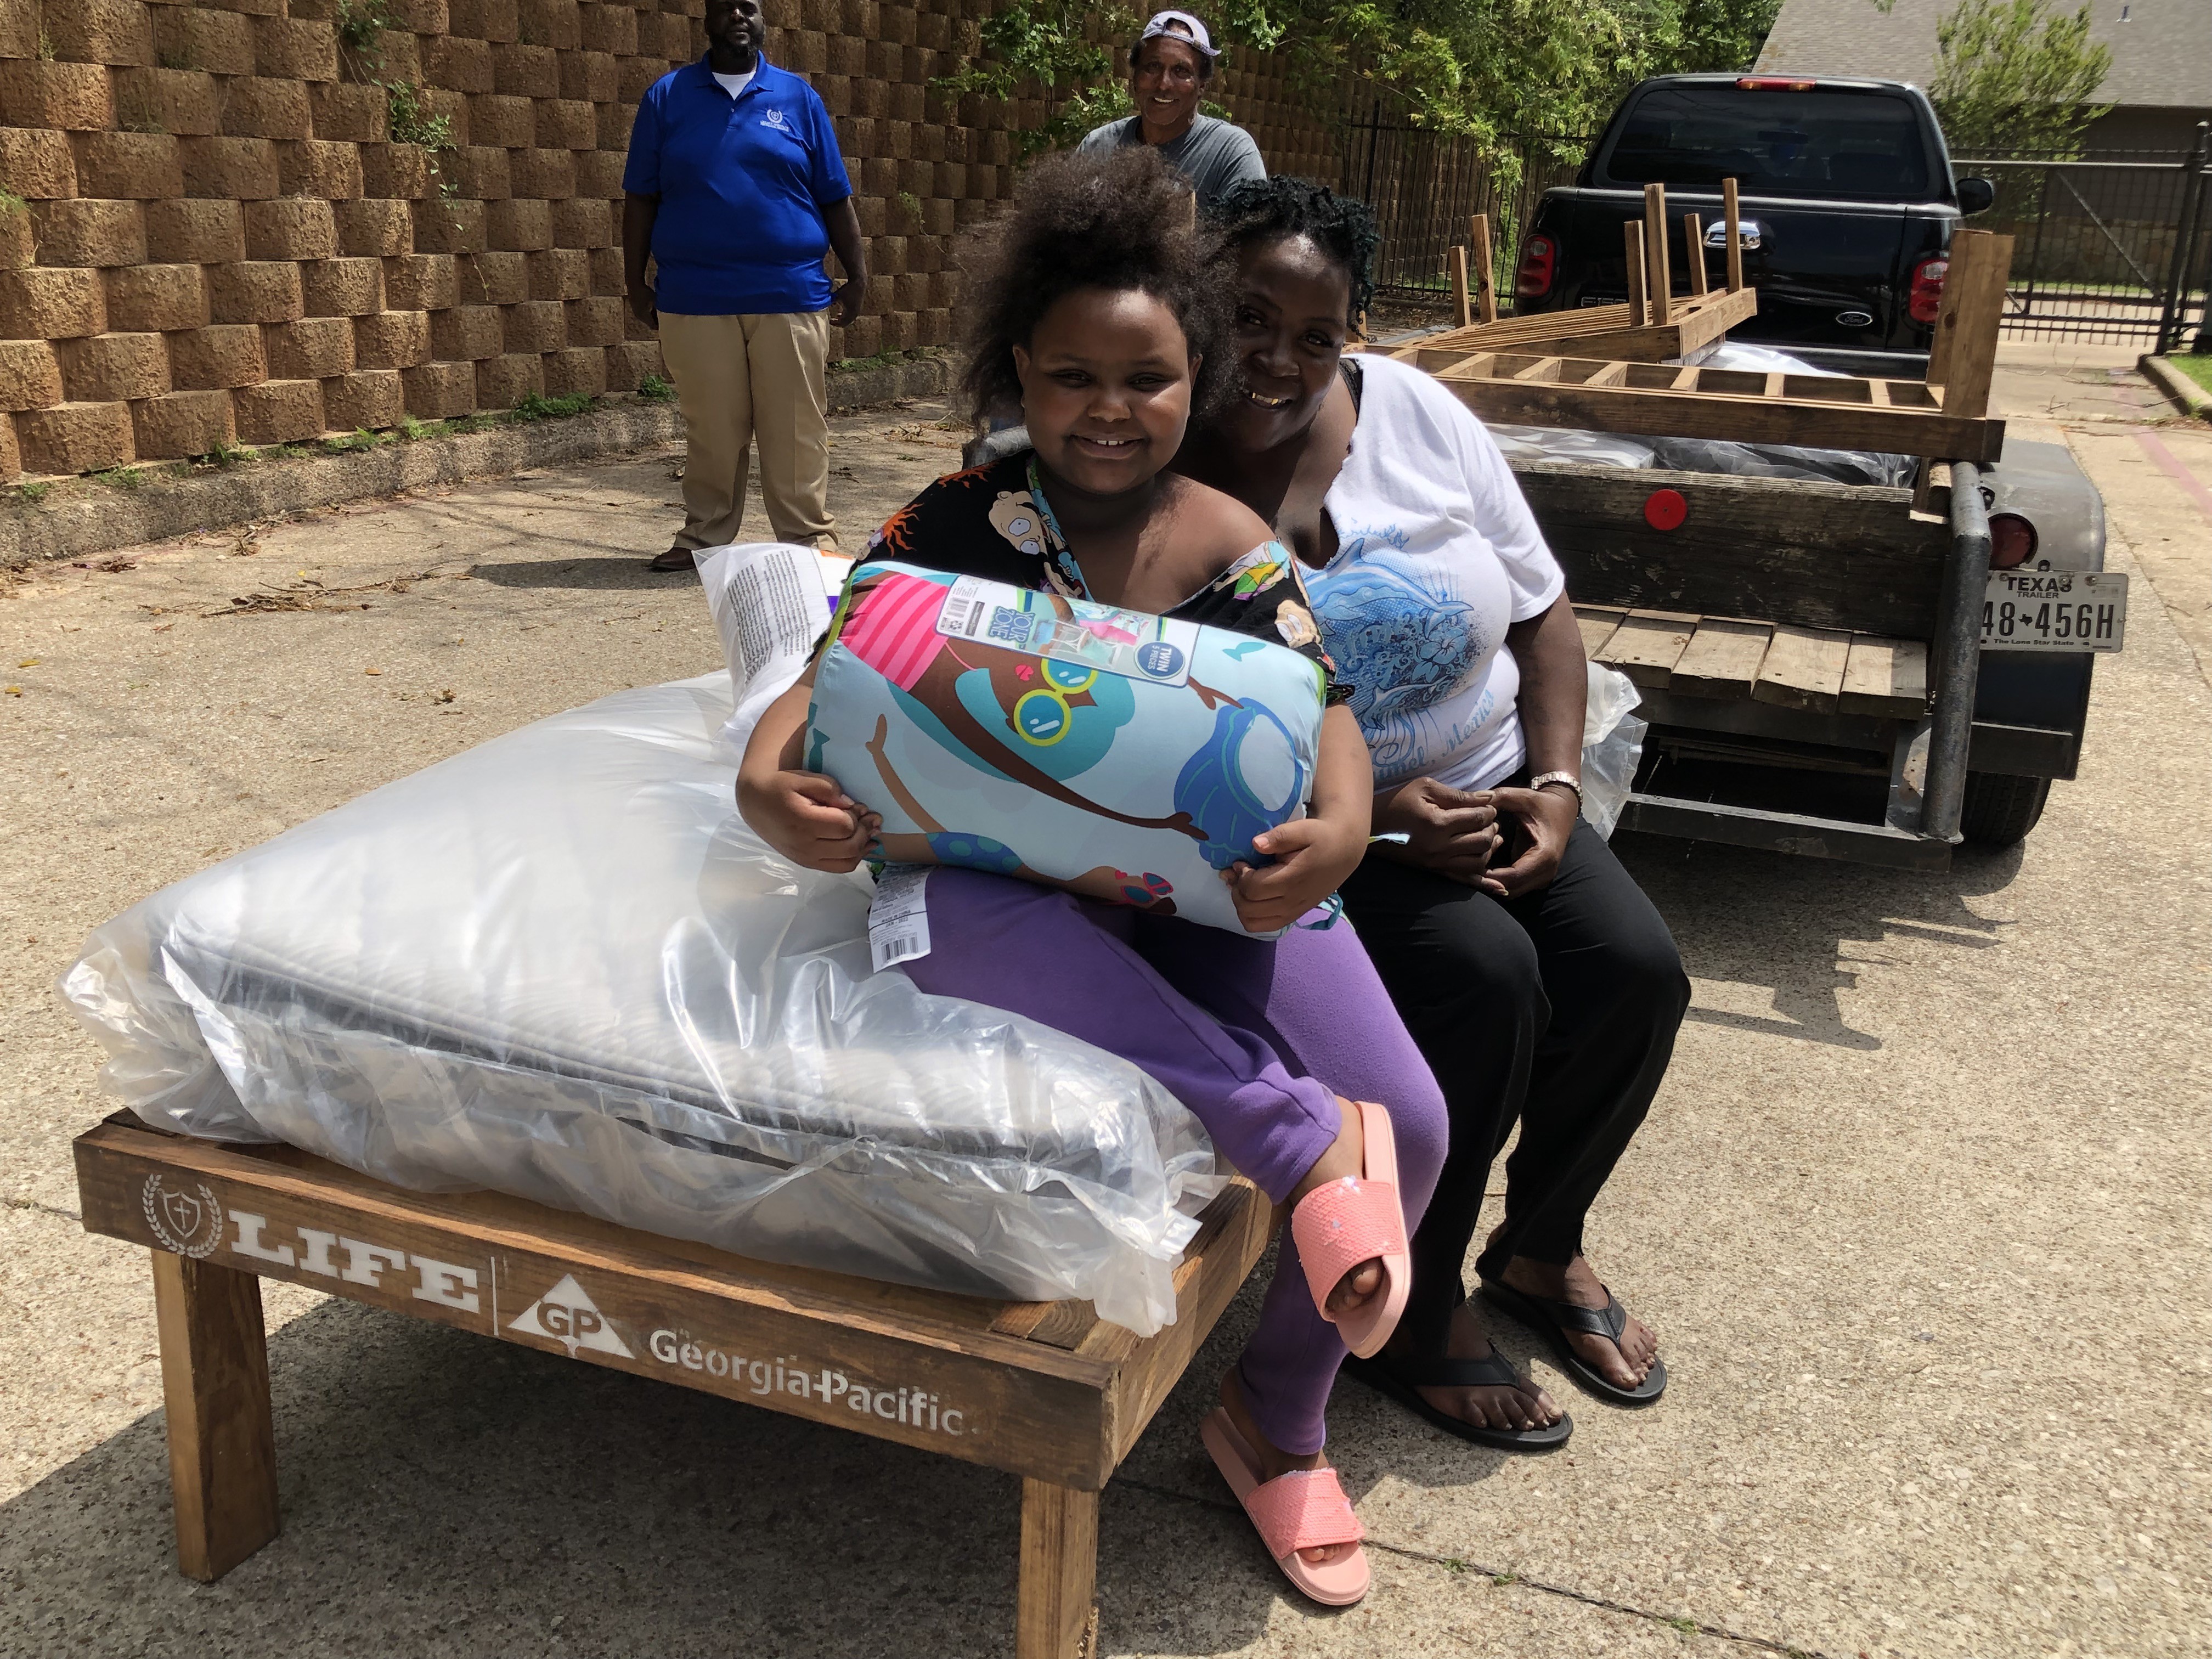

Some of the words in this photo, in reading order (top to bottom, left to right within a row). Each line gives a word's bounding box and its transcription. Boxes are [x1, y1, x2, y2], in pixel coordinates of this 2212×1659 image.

[1844, 314, 1864, 323] Ford
[2008, 577, 2072, 592] TEXAS
[990, 607, 1015, 639] ZONE
[1009, 612, 1034, 642] YOUR
[1147, 650, 1159, 670] PIECES
[1156, 648, 1172, 673] TWIN
[1379, 746, 1436, 781] umel,
[1442, 689, 1494, 757] Mexico
[228, 1210, 480, 1314] LIFE
[537, 1303, 602, 1340] GP
